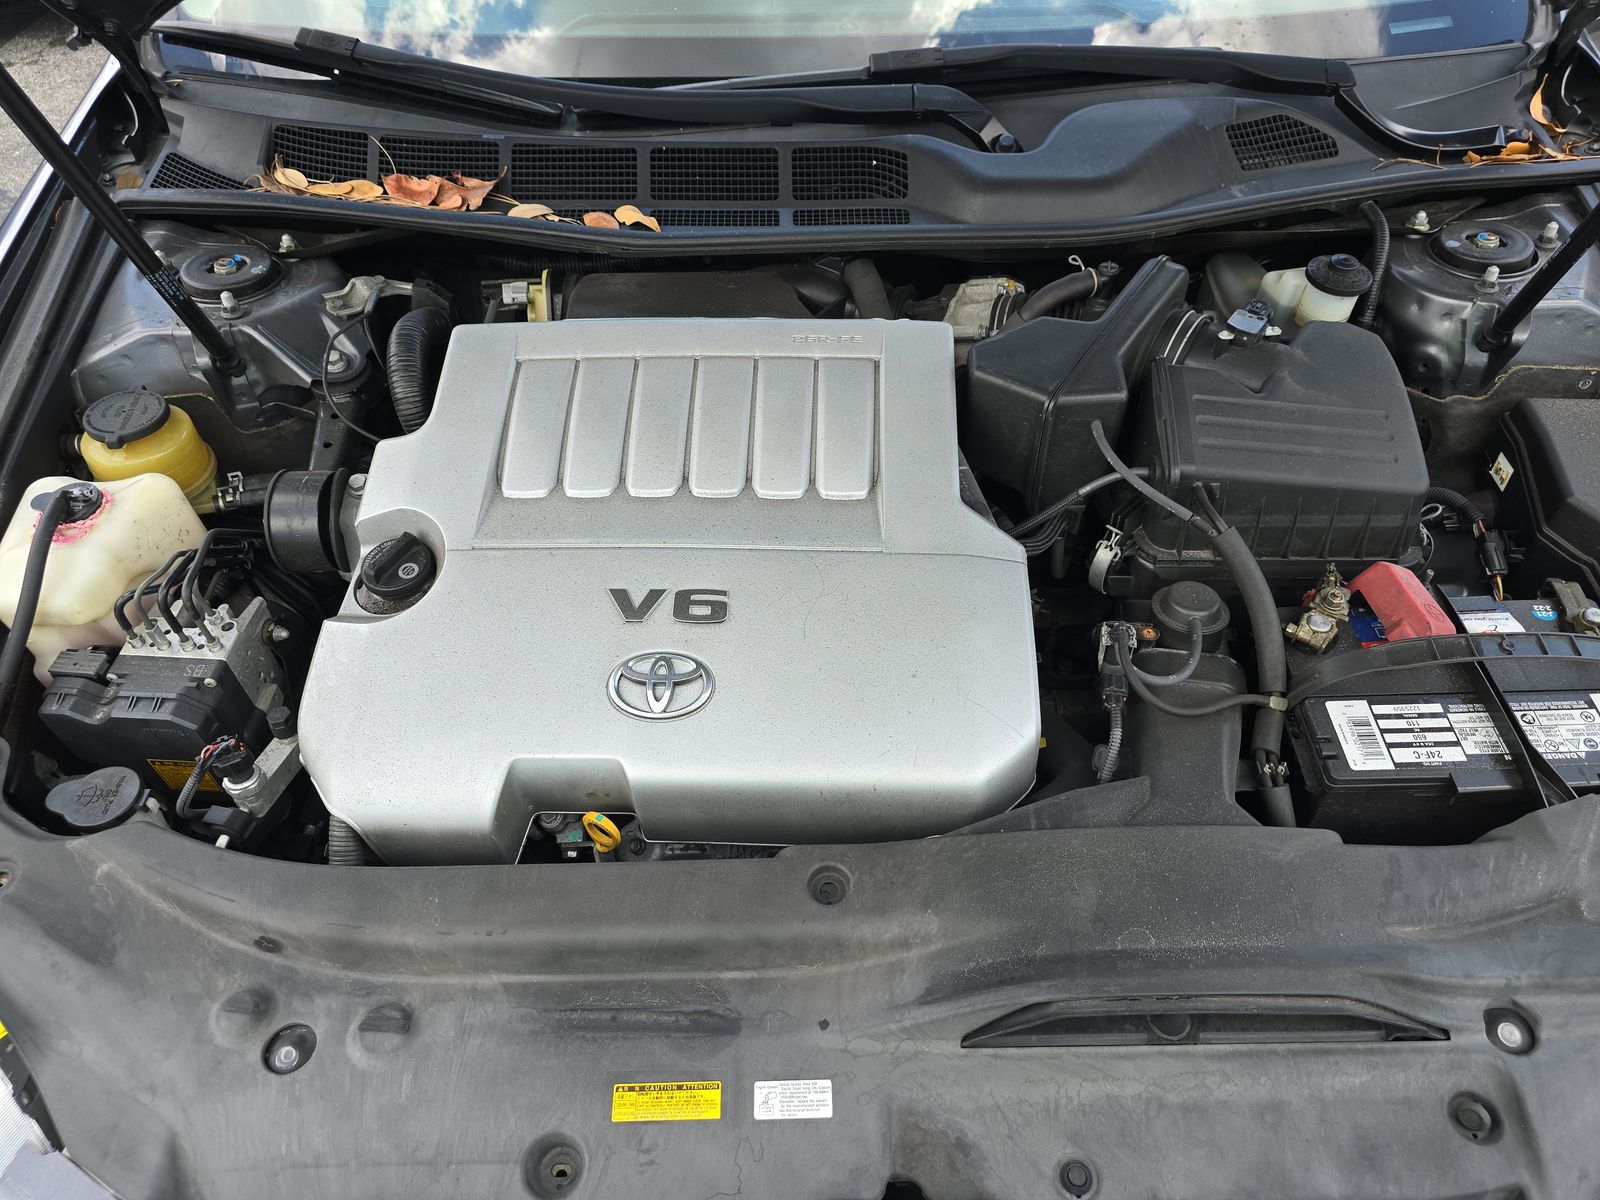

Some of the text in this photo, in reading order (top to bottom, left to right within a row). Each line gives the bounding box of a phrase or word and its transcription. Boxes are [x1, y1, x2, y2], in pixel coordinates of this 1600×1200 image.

[792, 335, 863, 344] 2GR-FE
[609, 588, 729, 624] V6
[1413, 750, 1443, 760] 24F-C
